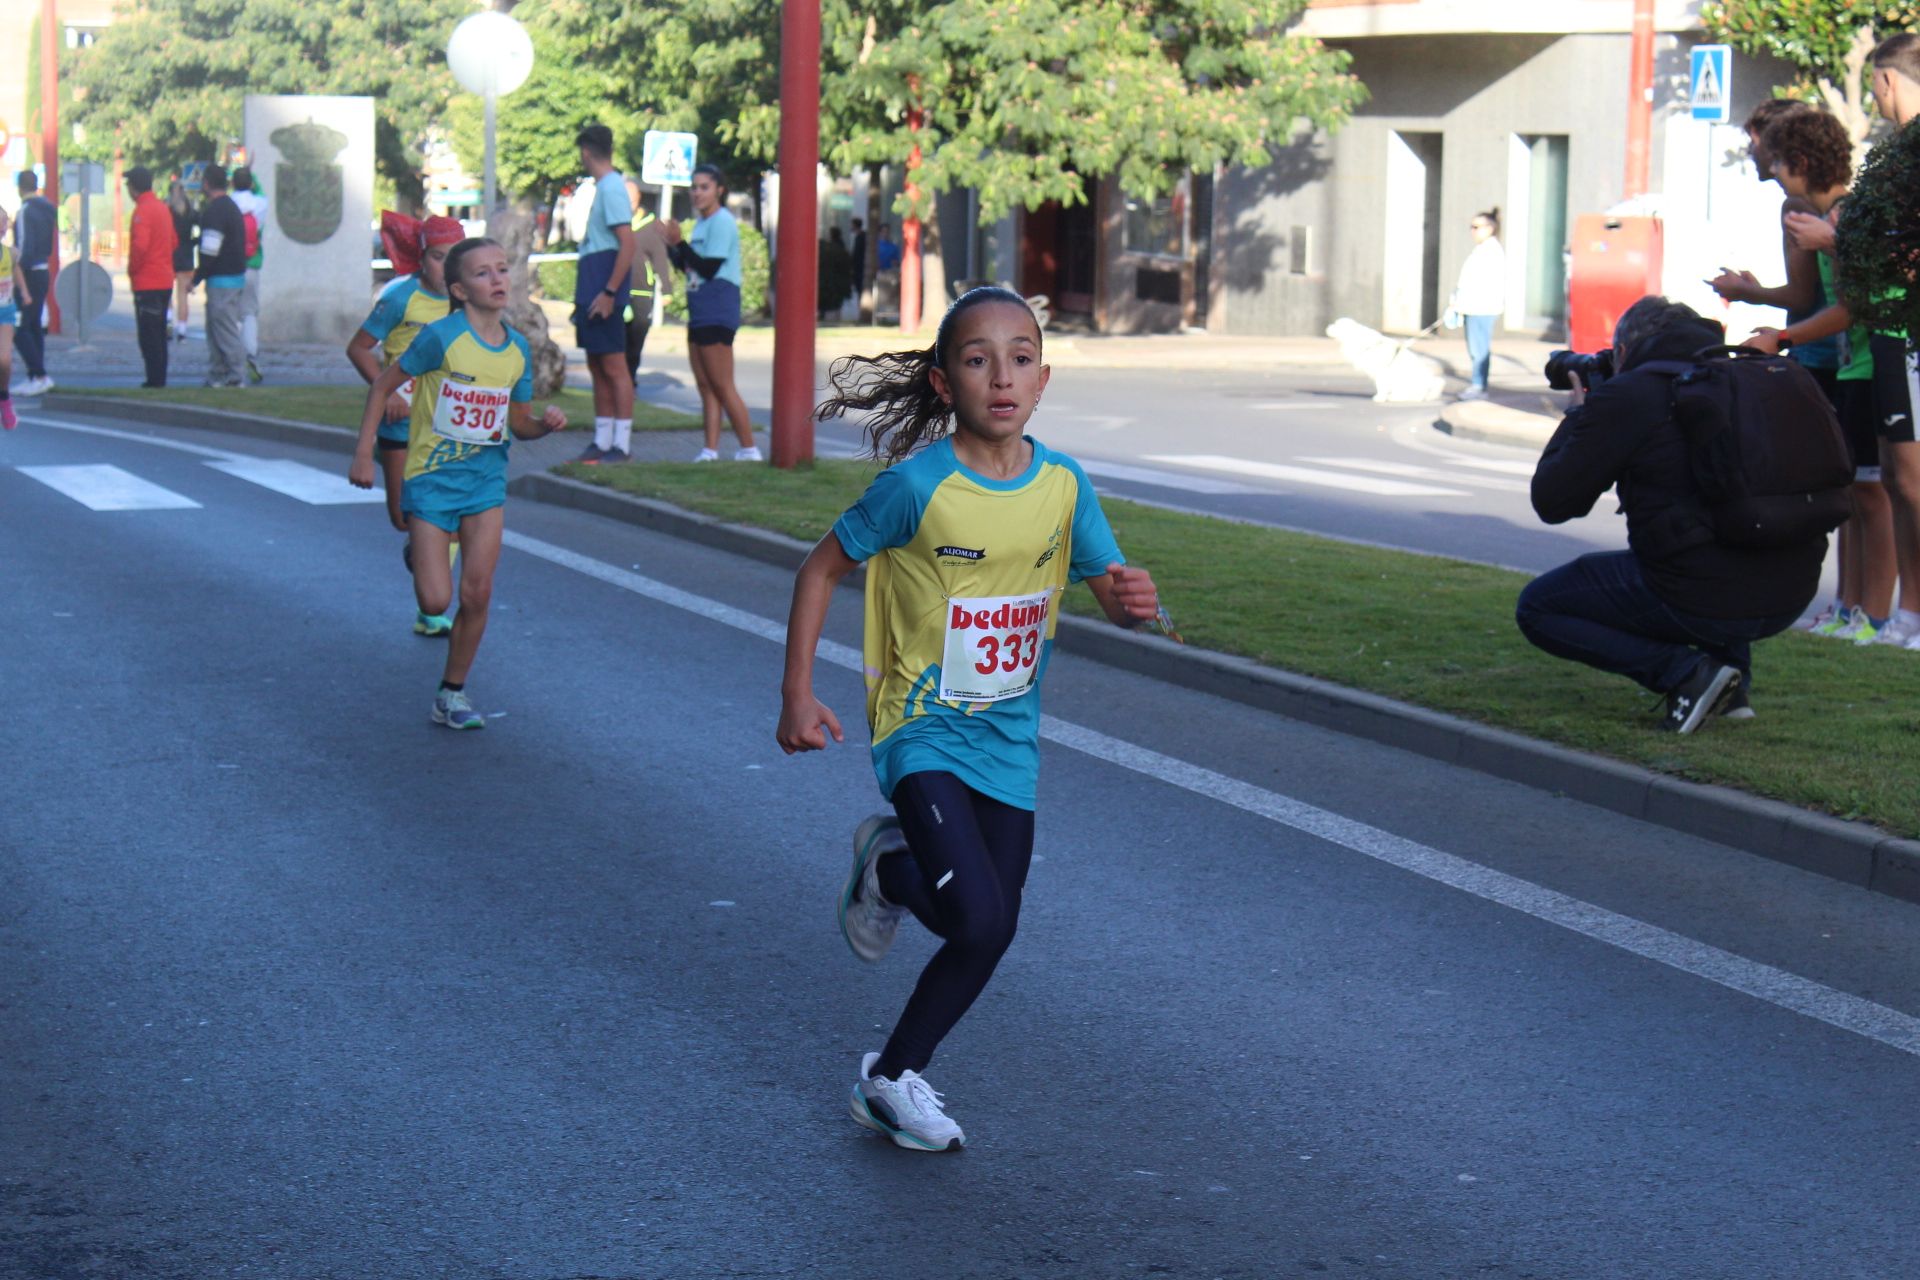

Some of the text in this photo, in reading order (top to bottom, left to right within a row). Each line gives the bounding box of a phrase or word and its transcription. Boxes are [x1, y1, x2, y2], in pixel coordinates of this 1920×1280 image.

[450, 405, 496, 430] 330
[943, 547, 978, 558] ALJOMAR
[975, 629, 1038, 675] 333
